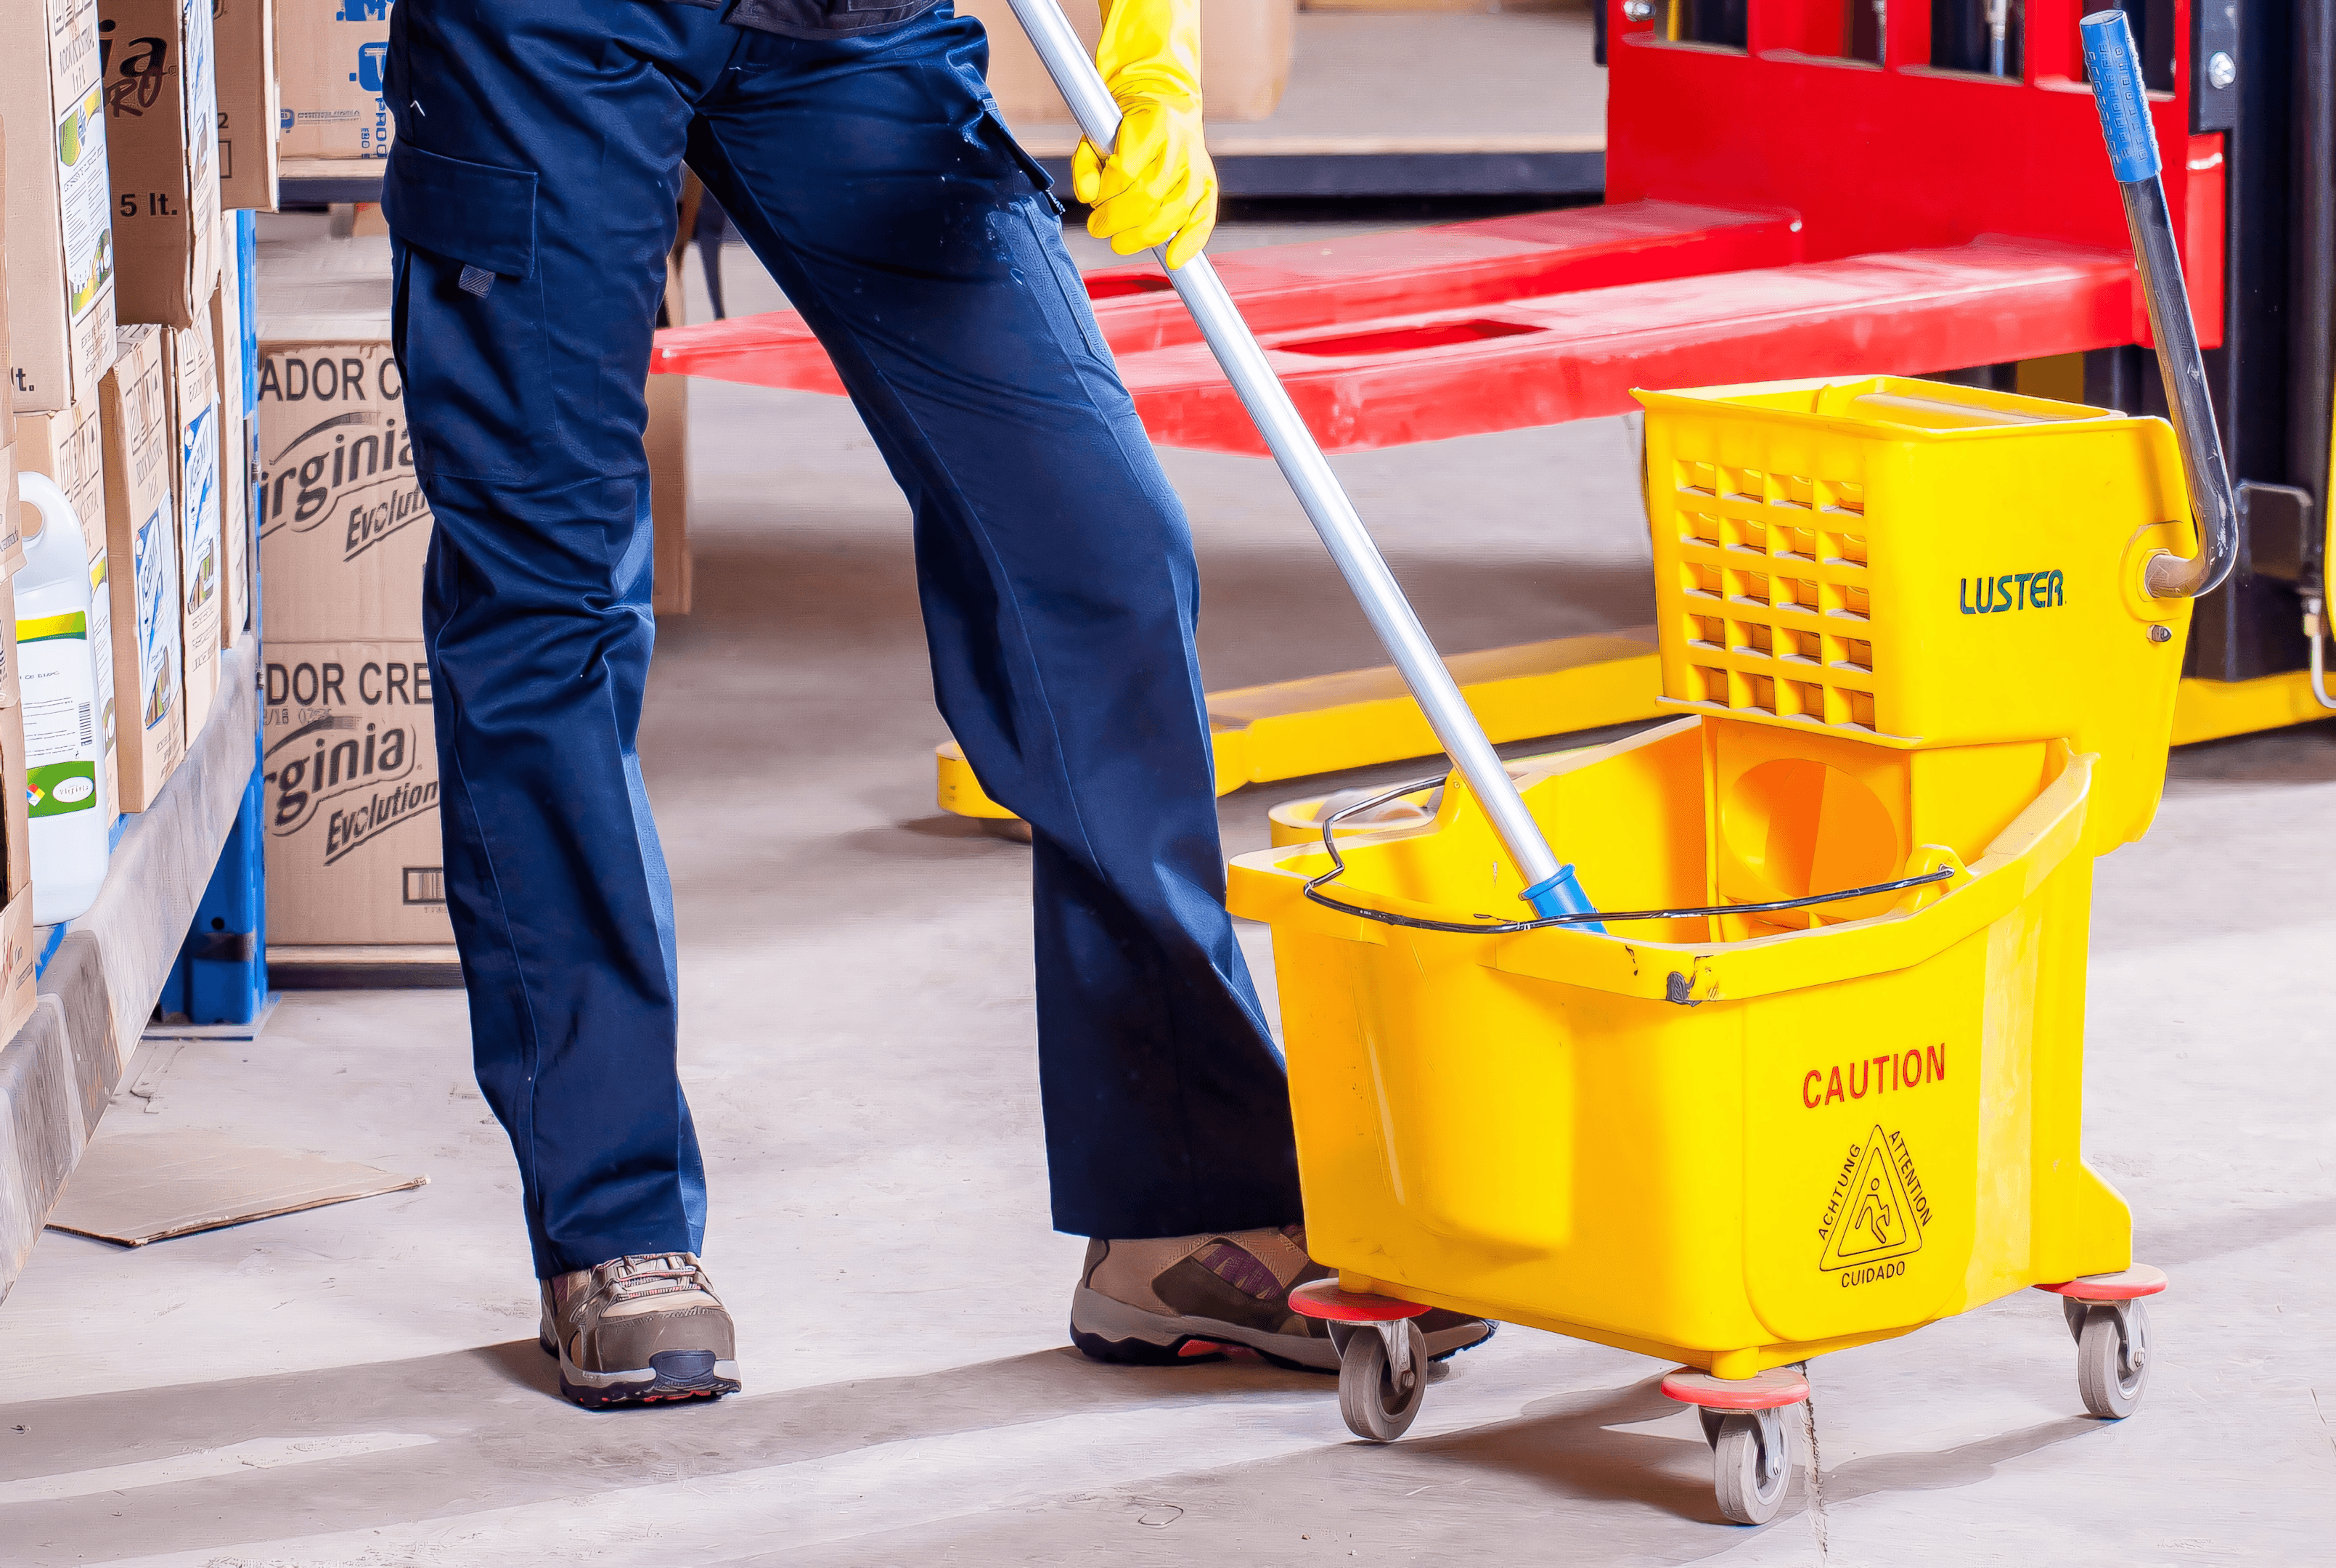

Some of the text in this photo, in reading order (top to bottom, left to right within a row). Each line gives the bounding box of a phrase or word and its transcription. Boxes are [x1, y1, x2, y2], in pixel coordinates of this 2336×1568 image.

[120, 192, 178, 217] 5 lt.
[258, 357, 367, 401] ADOR
[1960, 569, 2064, 615] LUSTER
[266, 661, 433, 706] DOR CRE
[326, 780, 439, 857] Evolution
[1802, 1042, 1945, 1108] CAUTION
[1818, 1143, 1861, 1241] ACHTUNG
[1888, 1130, 1933, 1227] ATTENTION
[1842, 1260, 1906, 1288] CUIDADO
